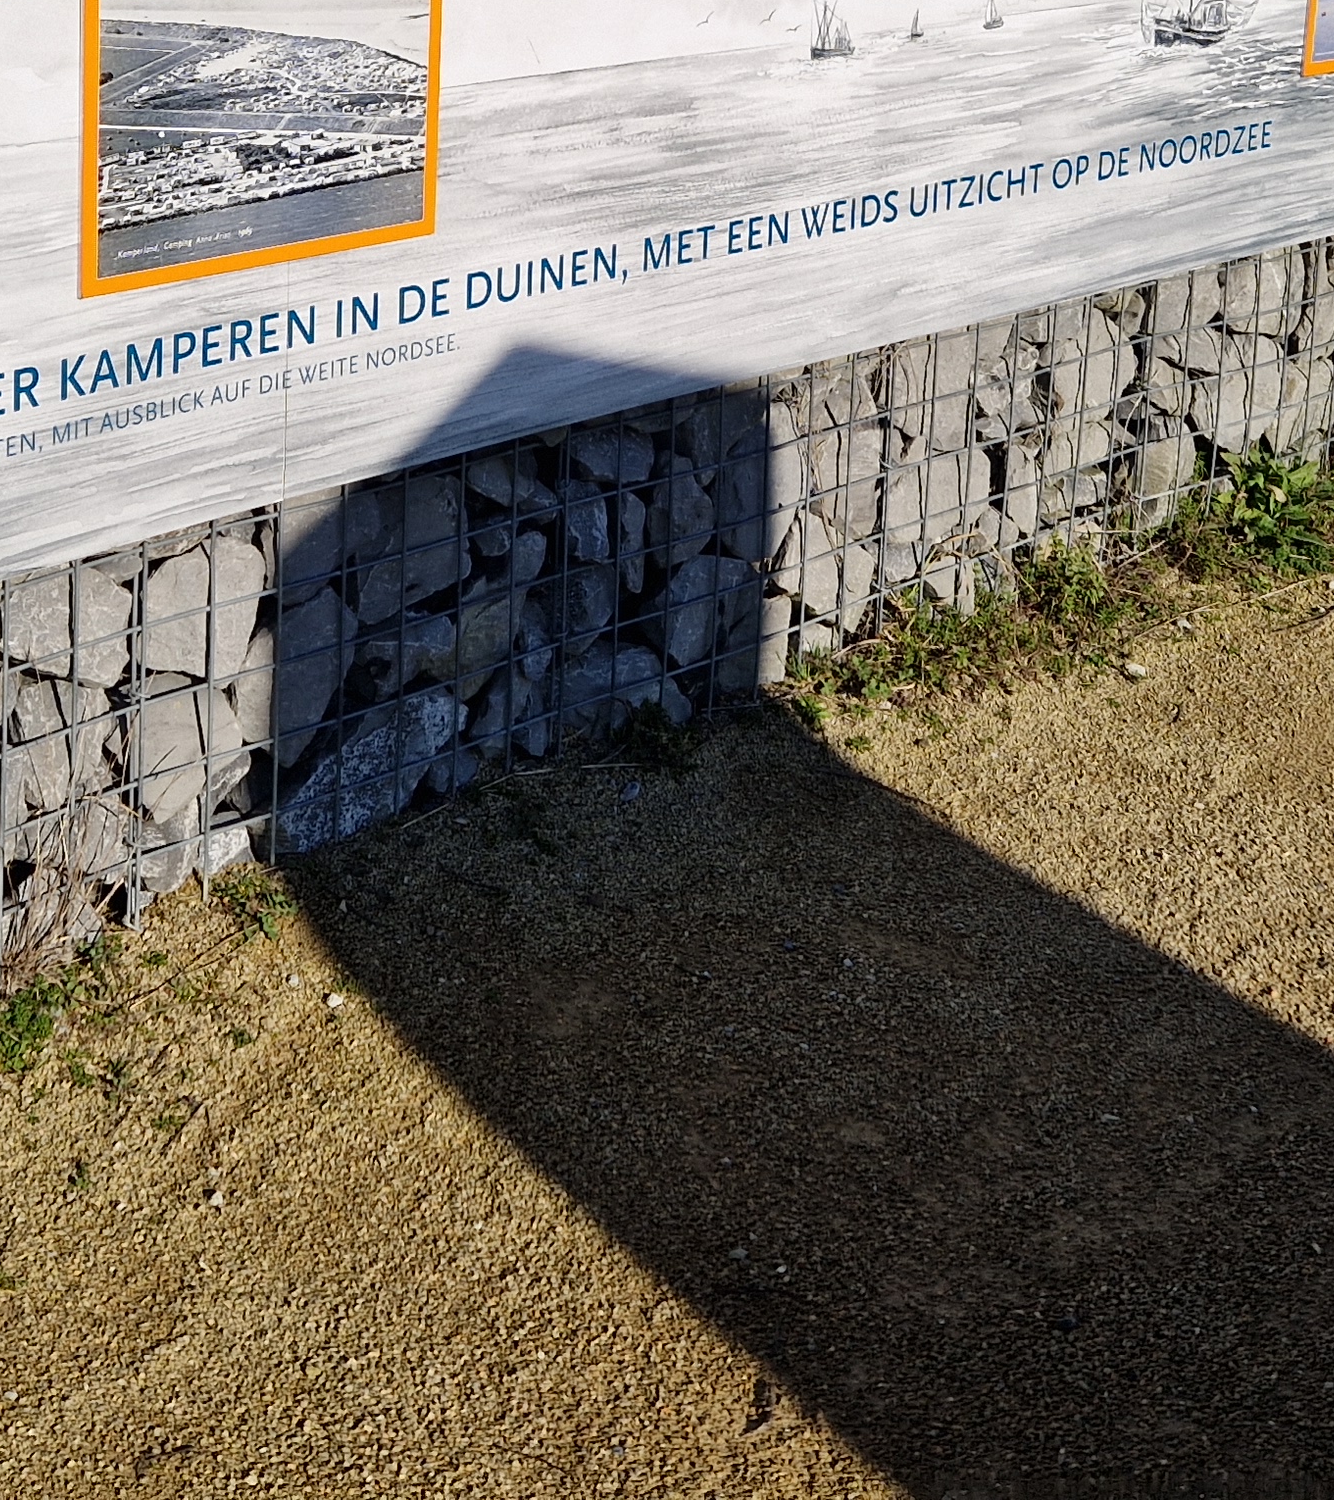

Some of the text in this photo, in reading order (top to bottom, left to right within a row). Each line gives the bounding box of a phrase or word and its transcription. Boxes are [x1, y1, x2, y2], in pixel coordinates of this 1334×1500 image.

[60, 304, 316, 401] KAMPEREN
[336, 296, 379, 339] IN
[398, 277, 450, 325] DE
[466, 243, 628, 311] DUINEN,
[642, 225, 716, 273] MET
[727, 211, 790, 255] EEN
[800, 189, 899, 240] WEIDS
[909, 162, 1045, 218] UITZICHT
[1051, 154, 1090, 190] OP
[1097, 146, 1131, 182] DE
[1139, 120, 1273, 173] NOORDZEE
[52, 415, 96, 445] MIT
[100, 389, 205, 434] AUSBLICK
[211, 379, 251, 406] AUF
[259, 367, 293, 393] DIE
[299, 354, 360, 388] WEITE
[366, 332, 460, 371] NORDSEE.
